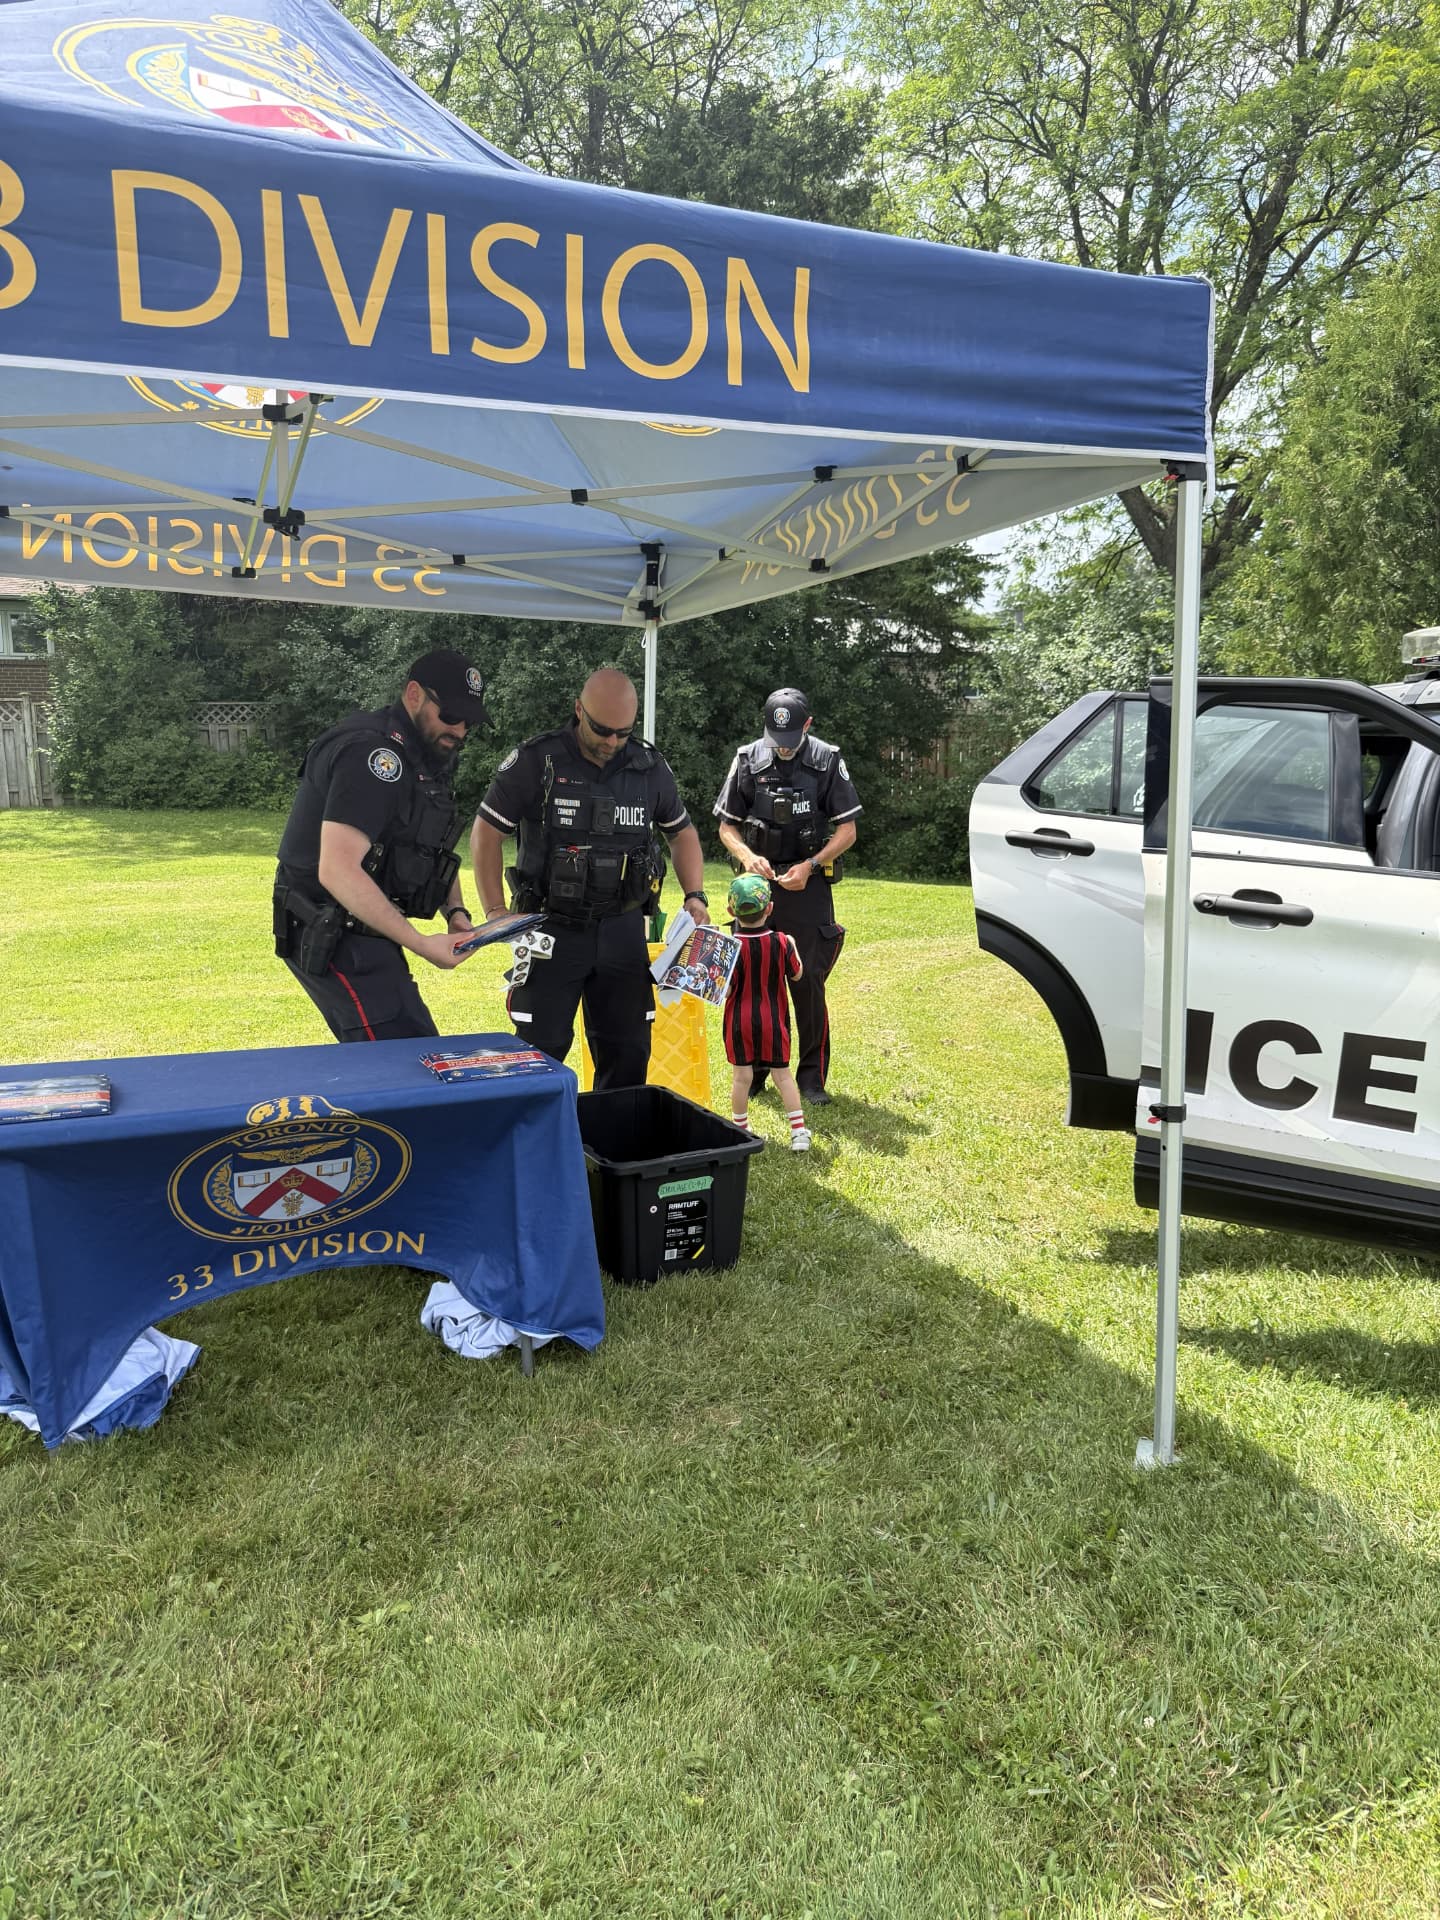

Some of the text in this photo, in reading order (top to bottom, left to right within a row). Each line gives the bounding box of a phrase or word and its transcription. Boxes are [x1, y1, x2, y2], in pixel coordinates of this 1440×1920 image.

[111, 169, 811, 393] DIVISION
[613, 806, 645, 826] POLICE
[712, 937, 724, 965] DATE!
[723, 941, 735, 969] SAVE
[1139, 1008, 1426, 1133] ICE
[226, 1123, 360, 1148] TORONTO
[668, 1200, 700, 1210] RAMTUFF
[247, 1211, 336, 1236] POLICE
[167, 1231, 426, 1301] 33 DIVISION
